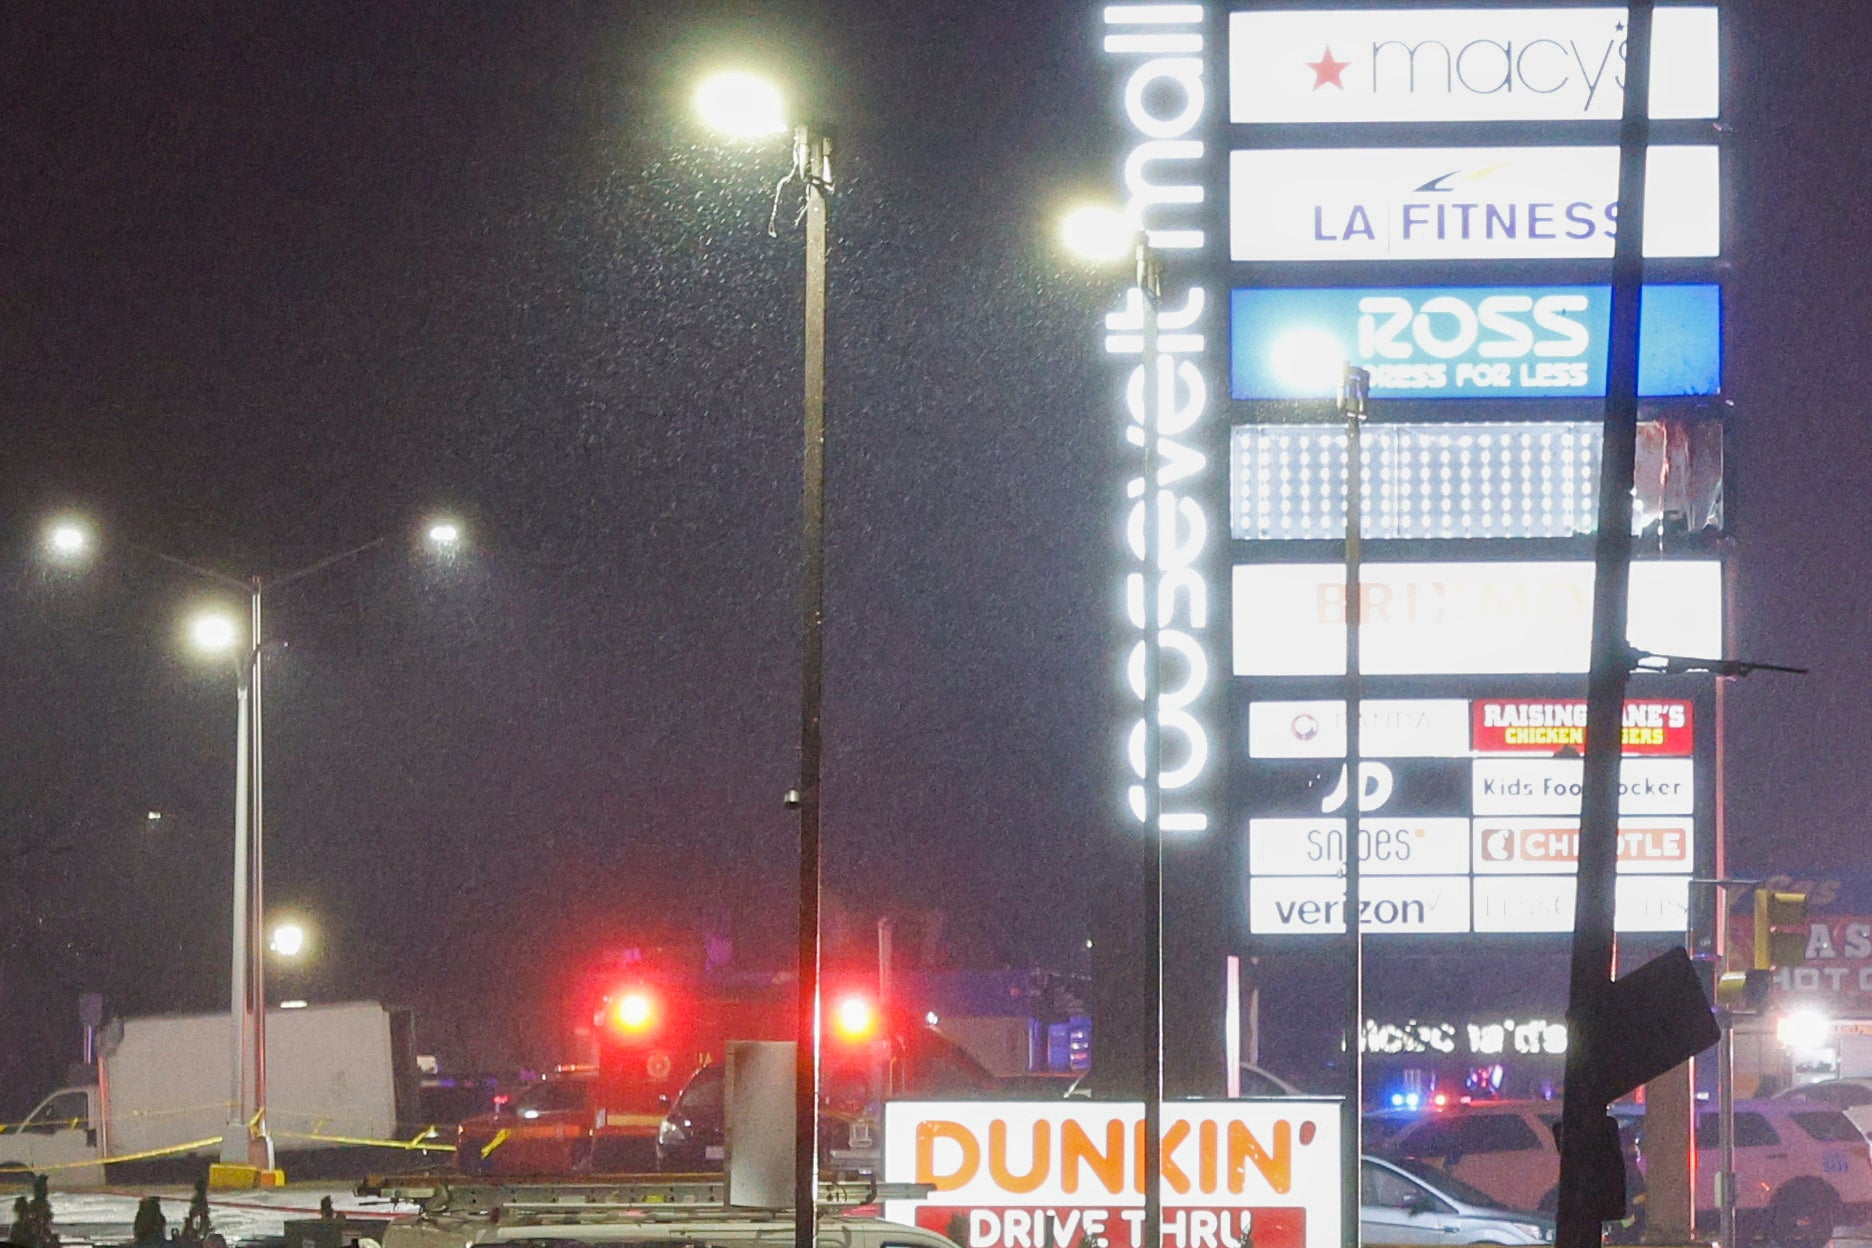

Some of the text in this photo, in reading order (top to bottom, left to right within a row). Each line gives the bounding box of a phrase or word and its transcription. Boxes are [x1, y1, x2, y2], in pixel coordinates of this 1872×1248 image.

[1314, 204, 1376, 241] LA
[1357, 295, 1590, 359] ROSS
[1455, 363, 1511, 388] FOR
[1519, 363, 1589, 388] LESS
[1103, 4, 1207, 830] roosevelt mall
[1316, 583, 1585, 625] BRIXMO
[1484, 704, 1685, 728] RAISING ANE'S
[1505, 726, 1584, 745] CHICKEN
[1484, 778, 1682, 797] Kids Foo ocker
[1306, 829, 1411, 861] snes
[1525, 833, 1681, 858] CHITLE
[1772, 966, 1849, 992] HOT
[915, 1118, 1317, 1195] DUNKIN'
[969, 1208, 1253, 1248] DRIVE THRU
